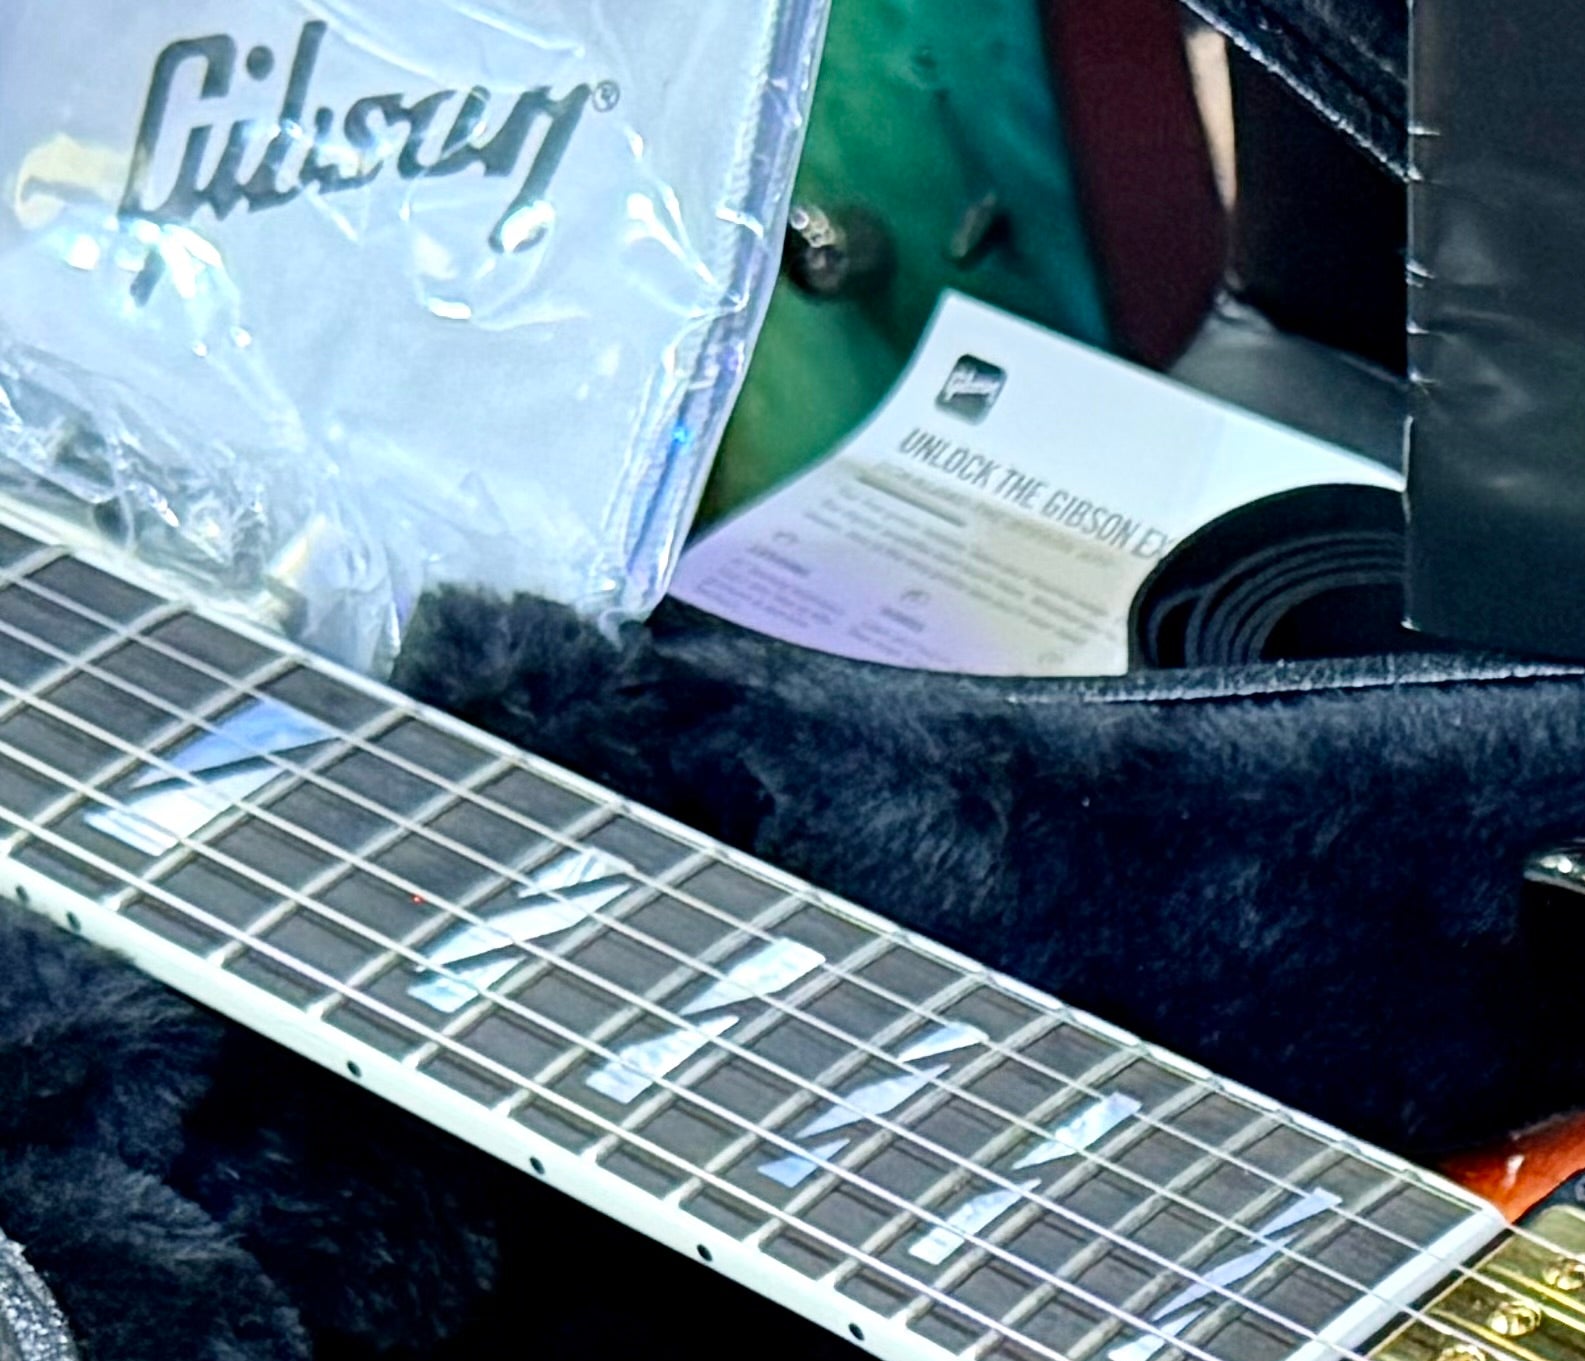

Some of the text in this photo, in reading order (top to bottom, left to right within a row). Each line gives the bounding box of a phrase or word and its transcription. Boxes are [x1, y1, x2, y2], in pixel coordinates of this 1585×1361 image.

[899, 428, 1000, 489] UNLOCK
[996, 467, 1048, 510] THE
[1041, 488, 1142, 548] GIBSON
